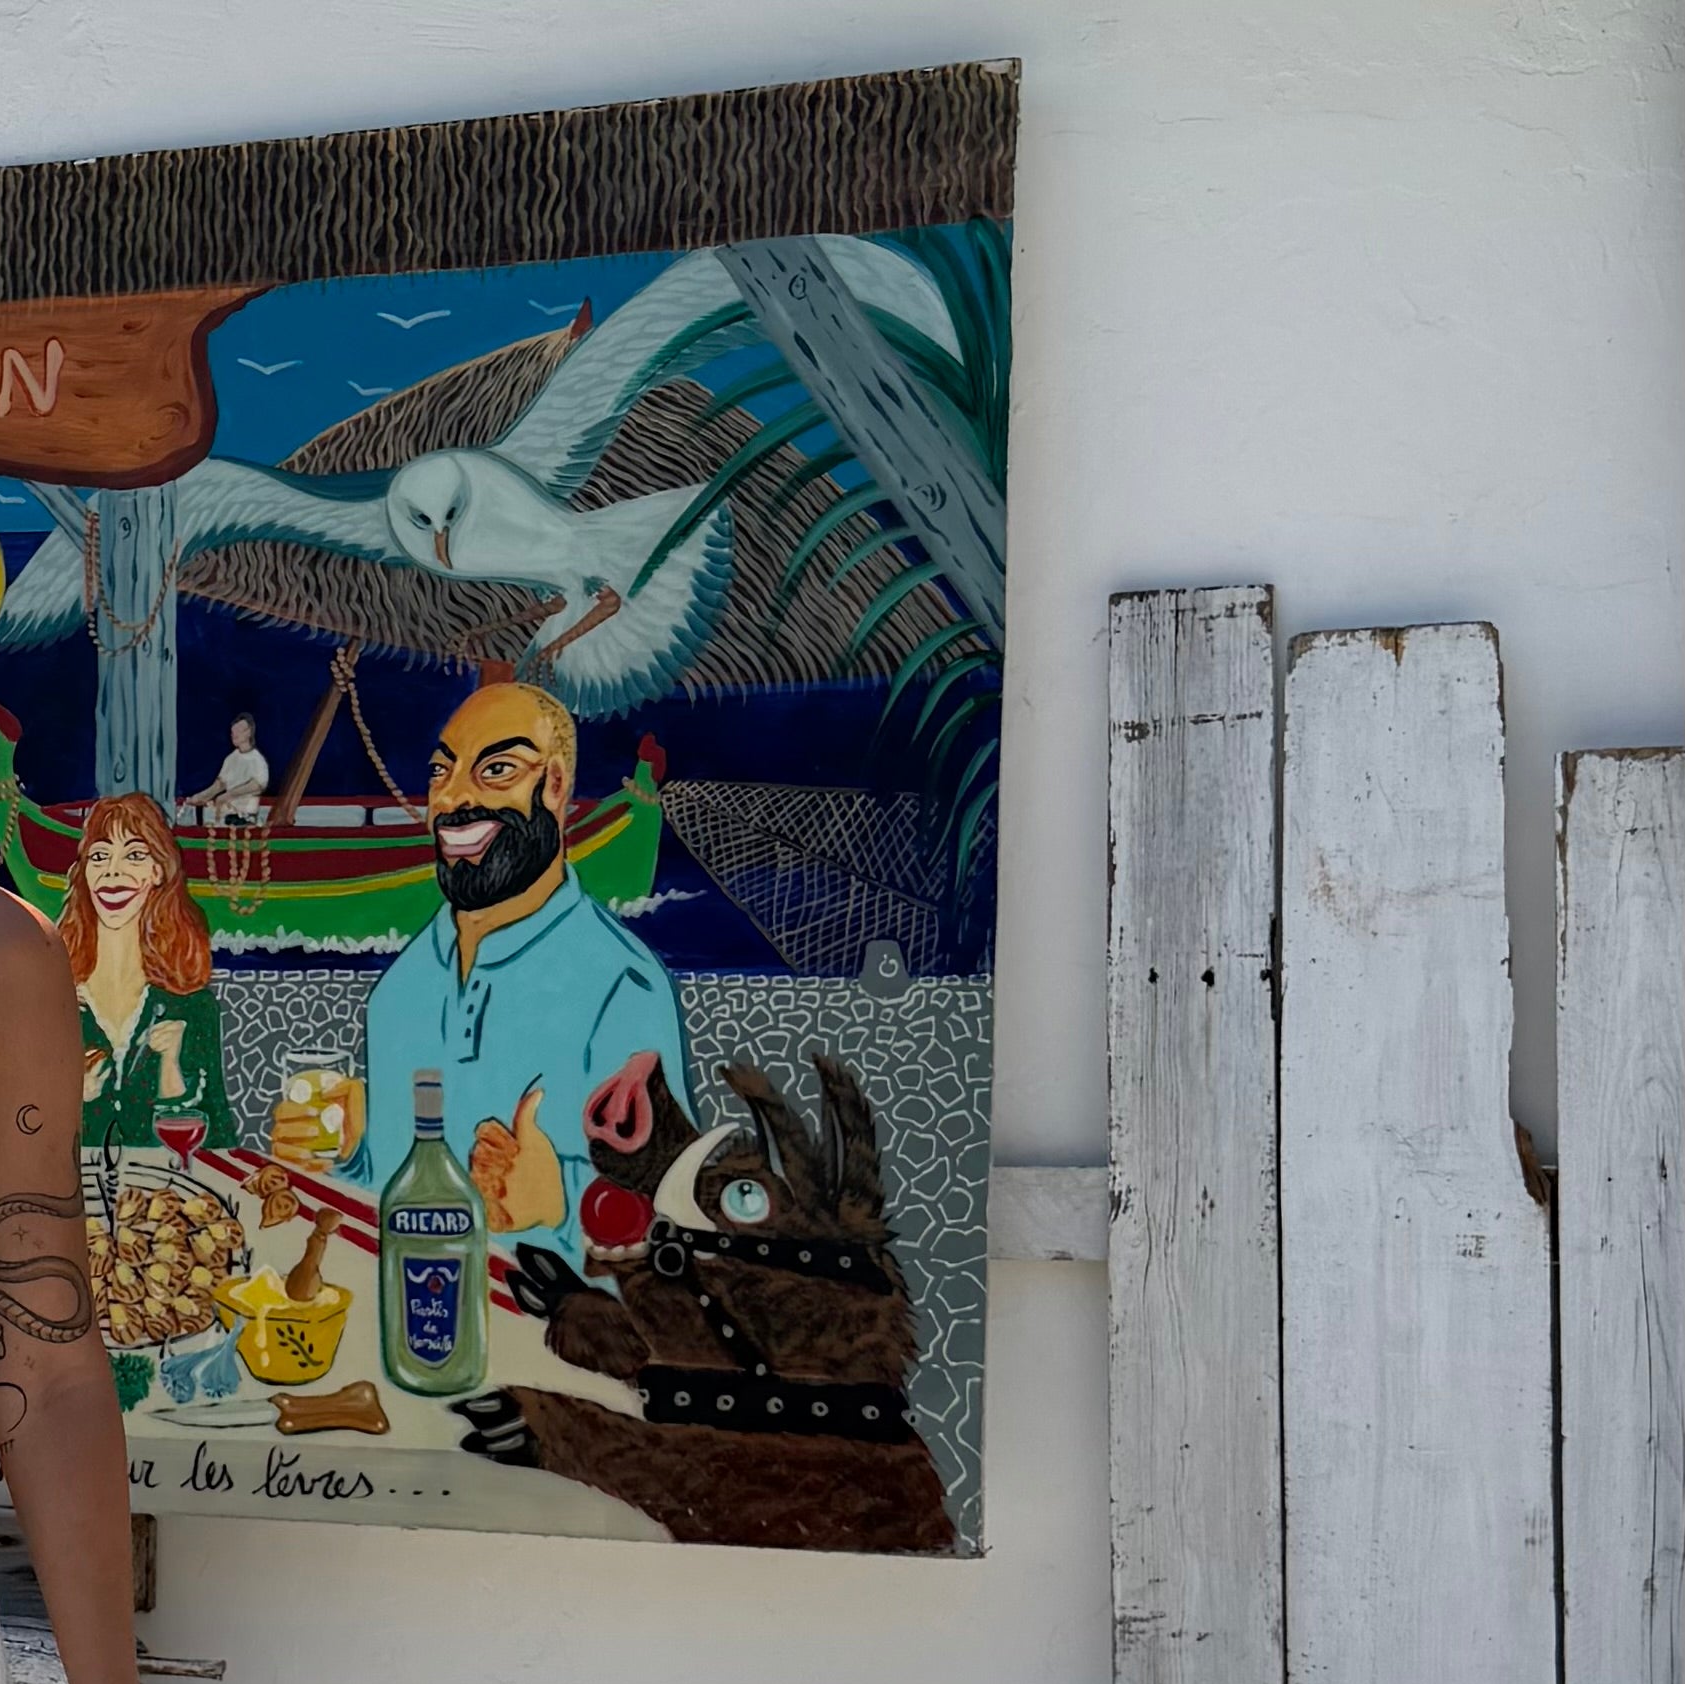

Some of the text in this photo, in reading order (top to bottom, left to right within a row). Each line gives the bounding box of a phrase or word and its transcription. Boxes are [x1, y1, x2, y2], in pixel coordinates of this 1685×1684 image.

[395, 1210, 470, 1233] RICARD
[128, 1459, 161, 1489] ur
[179, 1440, 234, 1493] les
